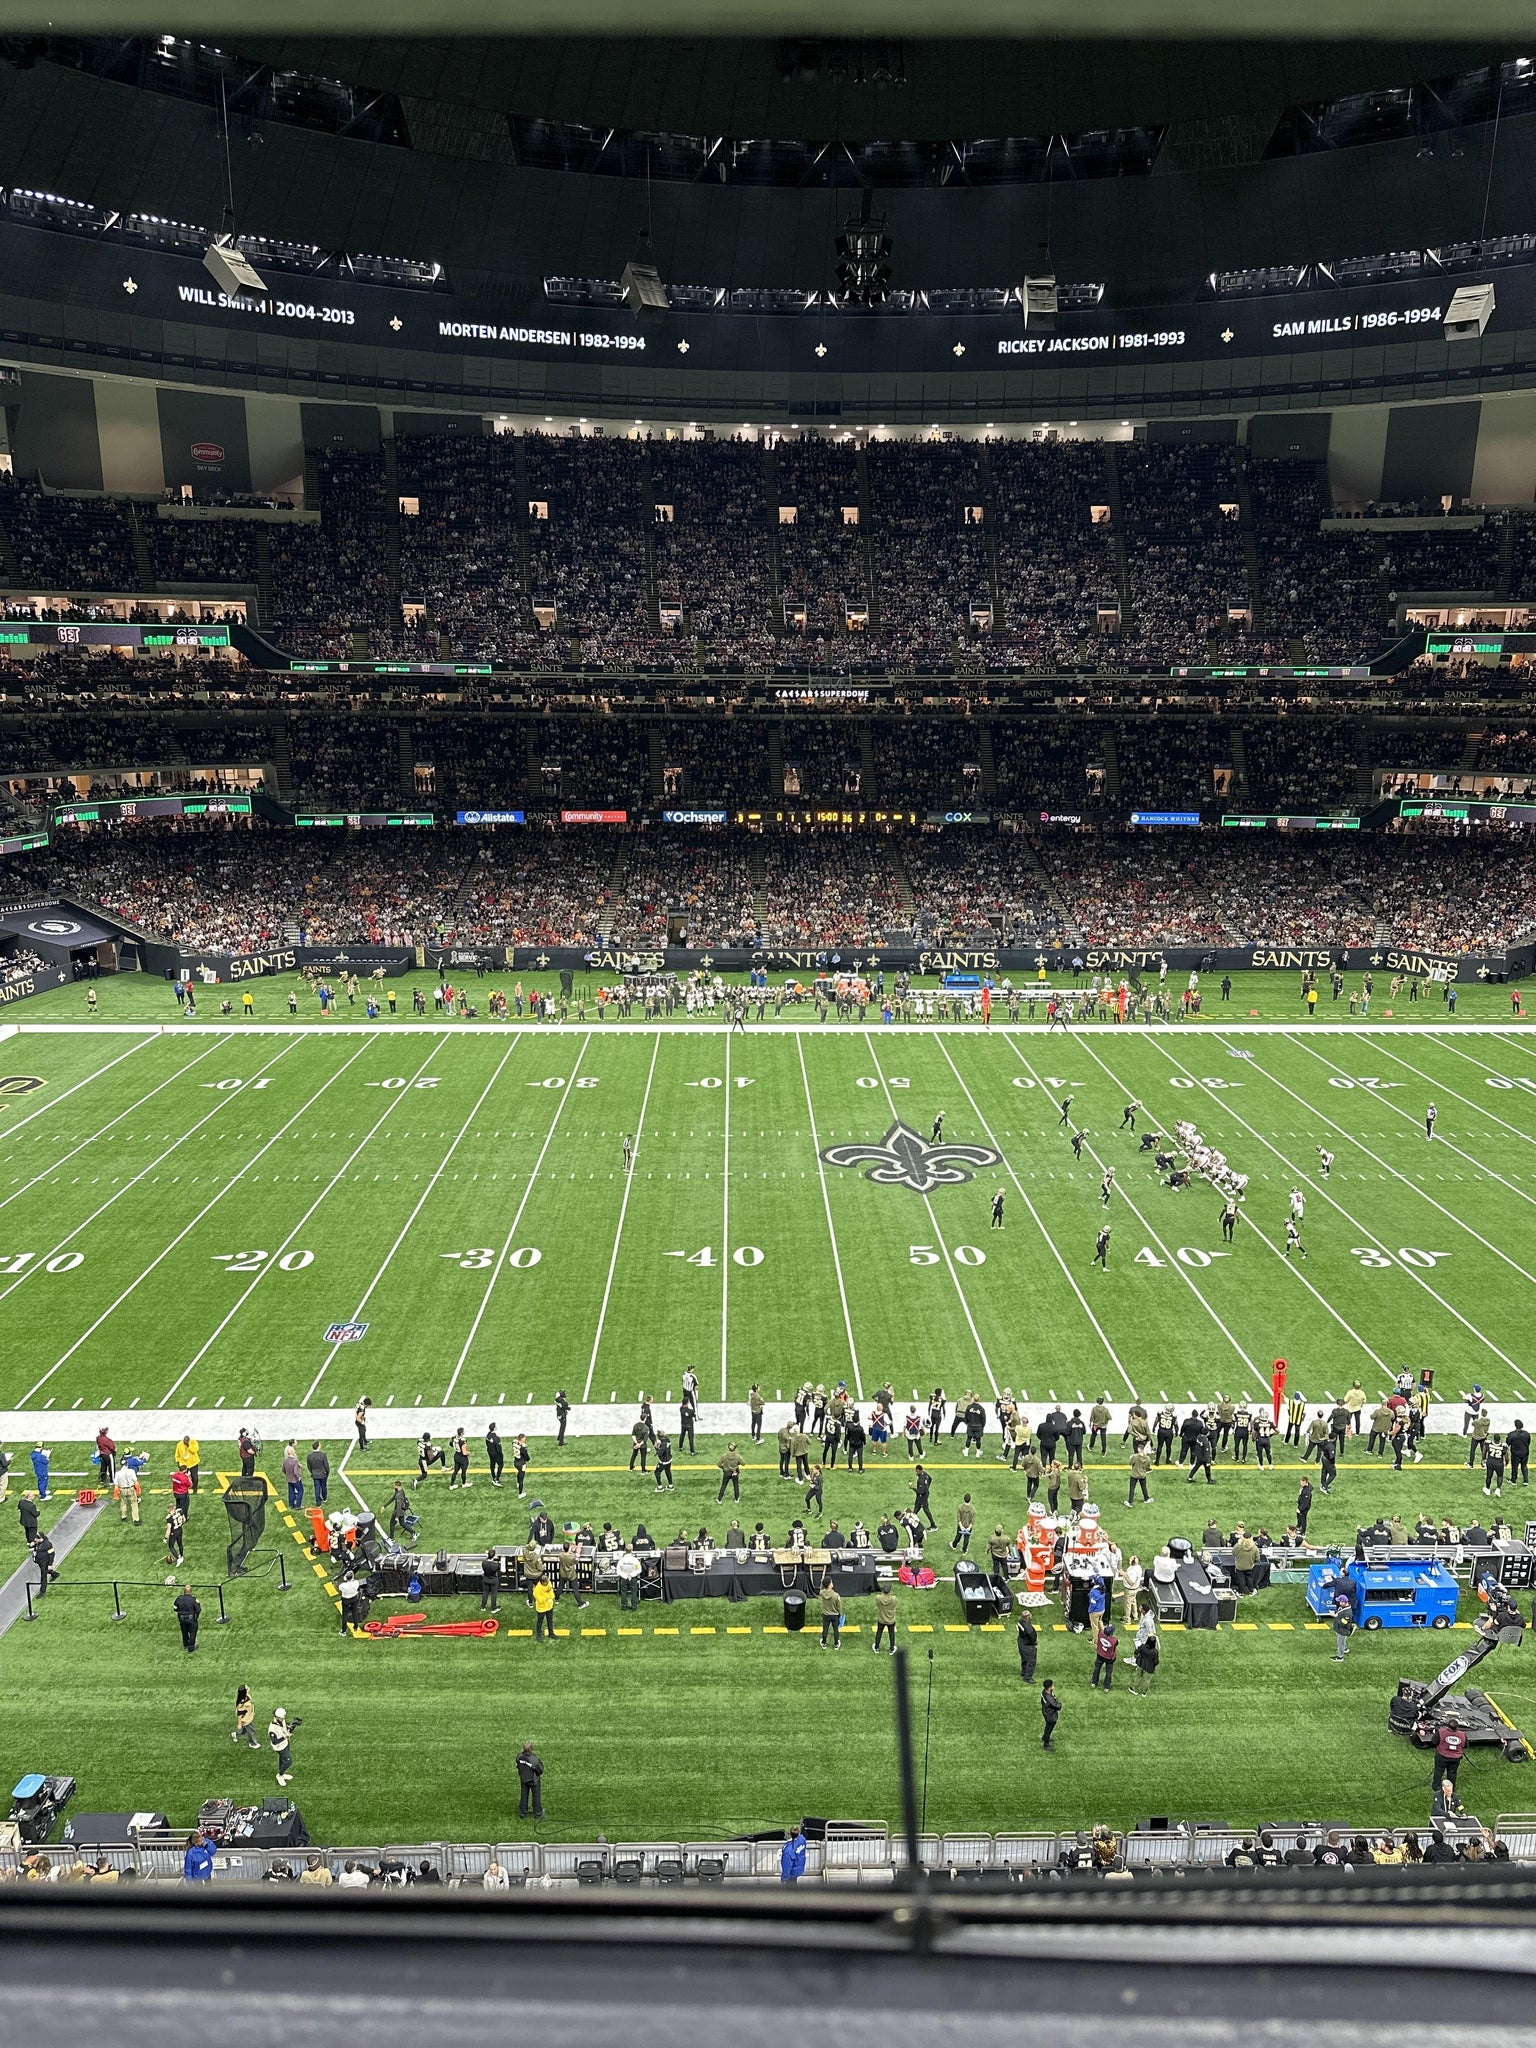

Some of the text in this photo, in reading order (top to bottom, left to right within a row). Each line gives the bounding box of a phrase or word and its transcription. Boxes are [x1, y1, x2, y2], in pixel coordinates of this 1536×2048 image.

[178, 285, 216, 306] WILL
[276, 302, 355, 325] 2004-2013
[1272, 306, 1441, 338] SAM MILLS 1986-1994
[439, 321, 646, 350] MORTEN ANDERSEN 1982-1994
[998, 331, 1186, 354] RICKEY JACKSON 1981-1993
[193, 447, 223, 458] Community
[57, 627, 80, 643] GET
[531, 664, 563, 672] SAINTS
[603, 665, 635, 673] SAINTS
[673, 666, 705, 674] SAINTS
[884, 667, 916, 675] SAINTS
[954, 667, 986, 675] SAINTS
[24, 685, 57, 693] SAINTS
[97, 684, 131, 692] SAINTS
[172, 684, 206, 692] SAINTS
[458, 686, 489, 694] SAINTS
[525, 687, 555, 695] SAINTS
[720, 689, 749, 697] SAINTS
[775, 689, 869, 697] CAESARS SUPERDOME
[894, 689, 923, 697] SAINTS
[1023, 689, 1053, 697] SAINTS
[1227, 689, 1258, 697] SAINTS
[1297, 689, 1329, 697] SAINTS
[1370, 690, 1403, 698] SAINTS
[1520, 691, 1536, 699] SAI
[119, 803, 136, 816] GET
[1490, 807, 1507, 819] GET
[526, 812, 558, 820] SAINTS
[564, 811, 603, 822] Community
[673, 811, 724, 823] Ochsner
[817, 812, 838, 821] 15:00
[842, 814, 852, 823] 36
[859, 814, 865, 823] 2
[945, 812, 972, 822] COX
[1050, 814, 1081, 823] entergy
[0, 903, 26, 913] AESARS
[230, 950, 295, 979] SAINTS
[920, 951, 995, 968] SAINTS
[1252, 951, 1331, 967] SAINTS
[303, 965, 331, 974] SAINTS
[1386, 952, 1458, 980] SAINTS
[0, 978, 35, 1002] AINTS
[855, 1077, 911, 1088] 50
[224, 1250, 315, 1271] 20
[458, 1247, 543, 1268] 30
[685, 1246, 765, 1267] 40
[909, 1245, 986, 1266] 50
[1133, 1247, 1212, 1267] 40
[1350, 1247, 1437, 1268] 30
[0, 1252, 85, 1273] 10
[330, 1330, 357, 1341] NFL
[80, 1491, 91, 1504] 20
[605, 1537, 618, 1551] 55
[792, 1533, 803, 1546] 12
[856, 1534, 867, 1547] 10
[1443, 1660, 1460, 1678] FOX
